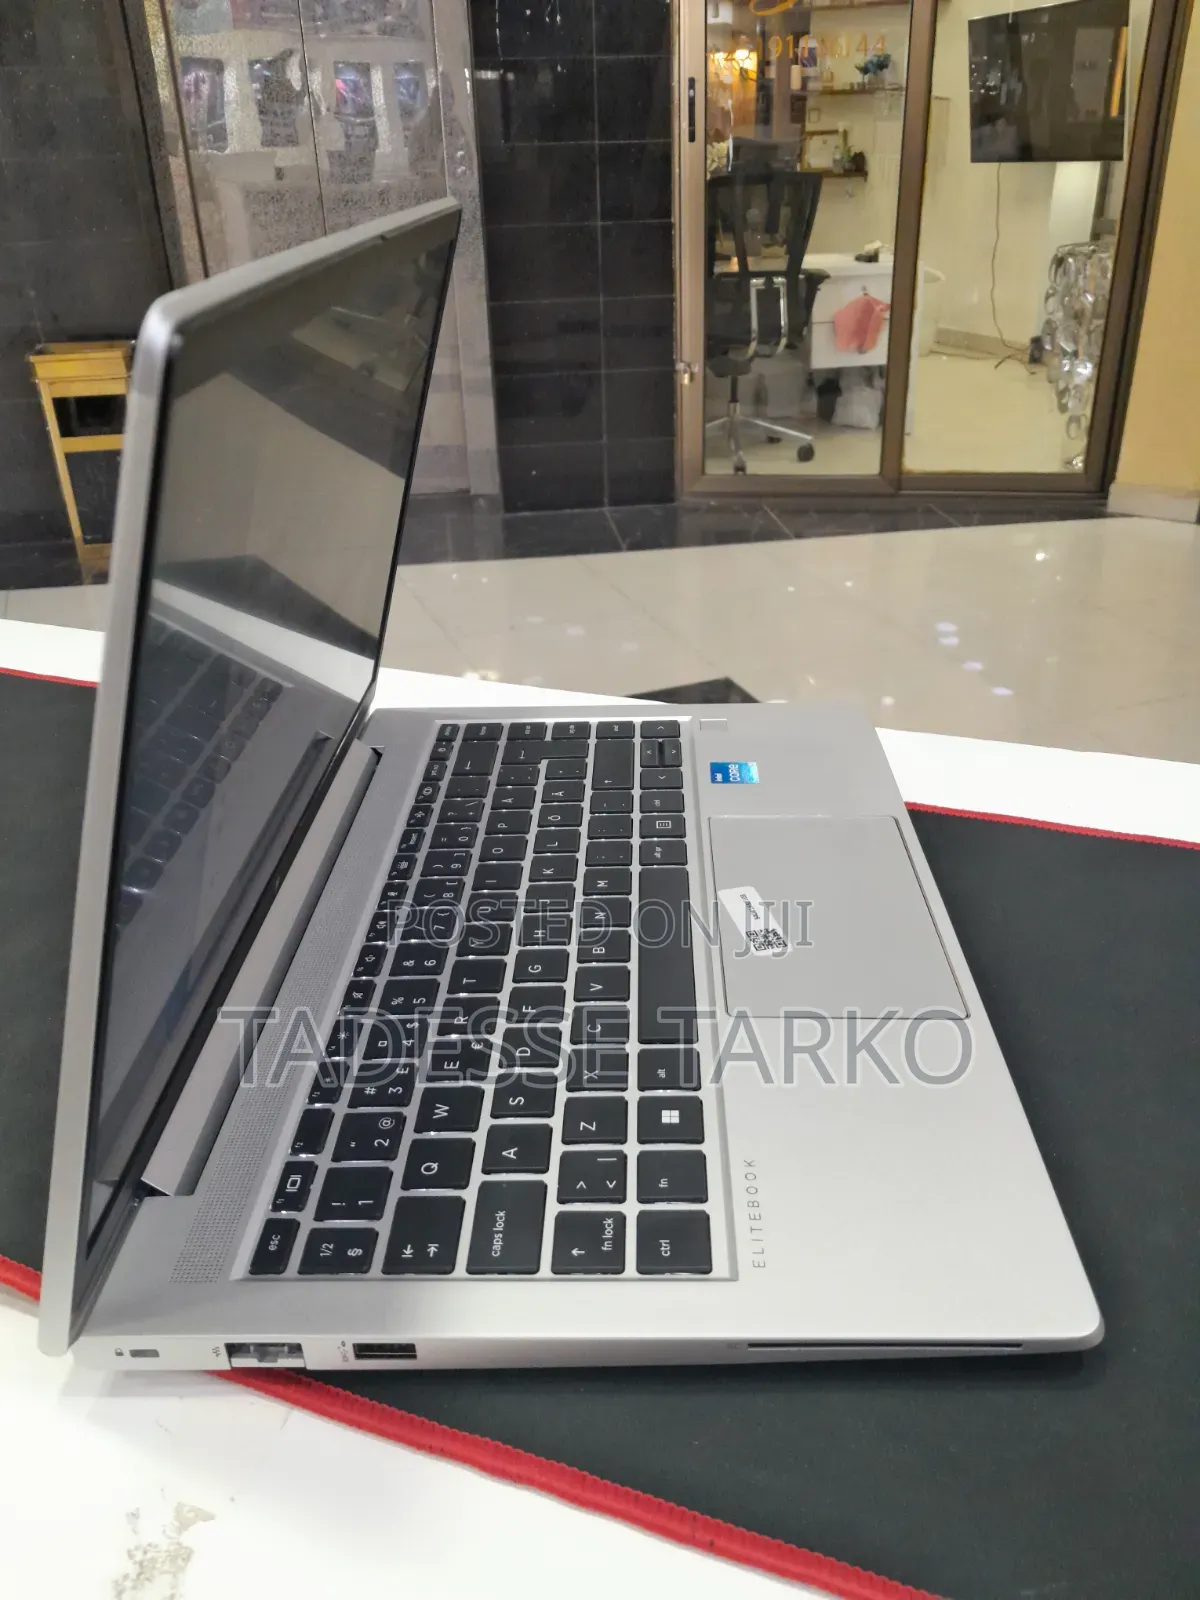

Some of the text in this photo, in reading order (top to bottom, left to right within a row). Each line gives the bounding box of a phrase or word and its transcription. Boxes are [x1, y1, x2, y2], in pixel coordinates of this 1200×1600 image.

[592, 946, 605, 954] B
[402, 959, 416, 967] &
[528, 964, 542, 973] G
[462, 977, 477, 985] T
[589, 982, 603, 992] V
[391, 996, 404, 1005] %
[522, 1004, 536, 1013] F
[454, 1015, 469, 1025] R
[587, 1023, 601, 1033] C
[401, 1039, 416, 1047] 4
[516, 1046, 531, 1057] D
[444, 1060, 460, 1069] E
[583, 1069, 599, 1079] X
[656, 1067, 667, 1079] alt
[364, 1086, 377, 1095] #
[388, 1086, 403, 1095] 3
[509, 1096, 525, 1106] S
[432, 1103, 450, 1119] W
[378, 1116, 396, 1130] @
[580, 1120, 596, 1132] Z
[374, 1137, 390, 1148] 2
[501, 1147, 518, 1160] A
[421, 1161, 439, 1175] Q
[658, 1178, 669, 1188] fn
[743, 1158, 767, 1269] ELITEBOOK
[491, 1210, 507, 1257] caps lock
[601, 1217, 614, 1251] fn lock
[268, 1233, 281, 1251] esc
[659, 1239, 671, 1257] ctrl
